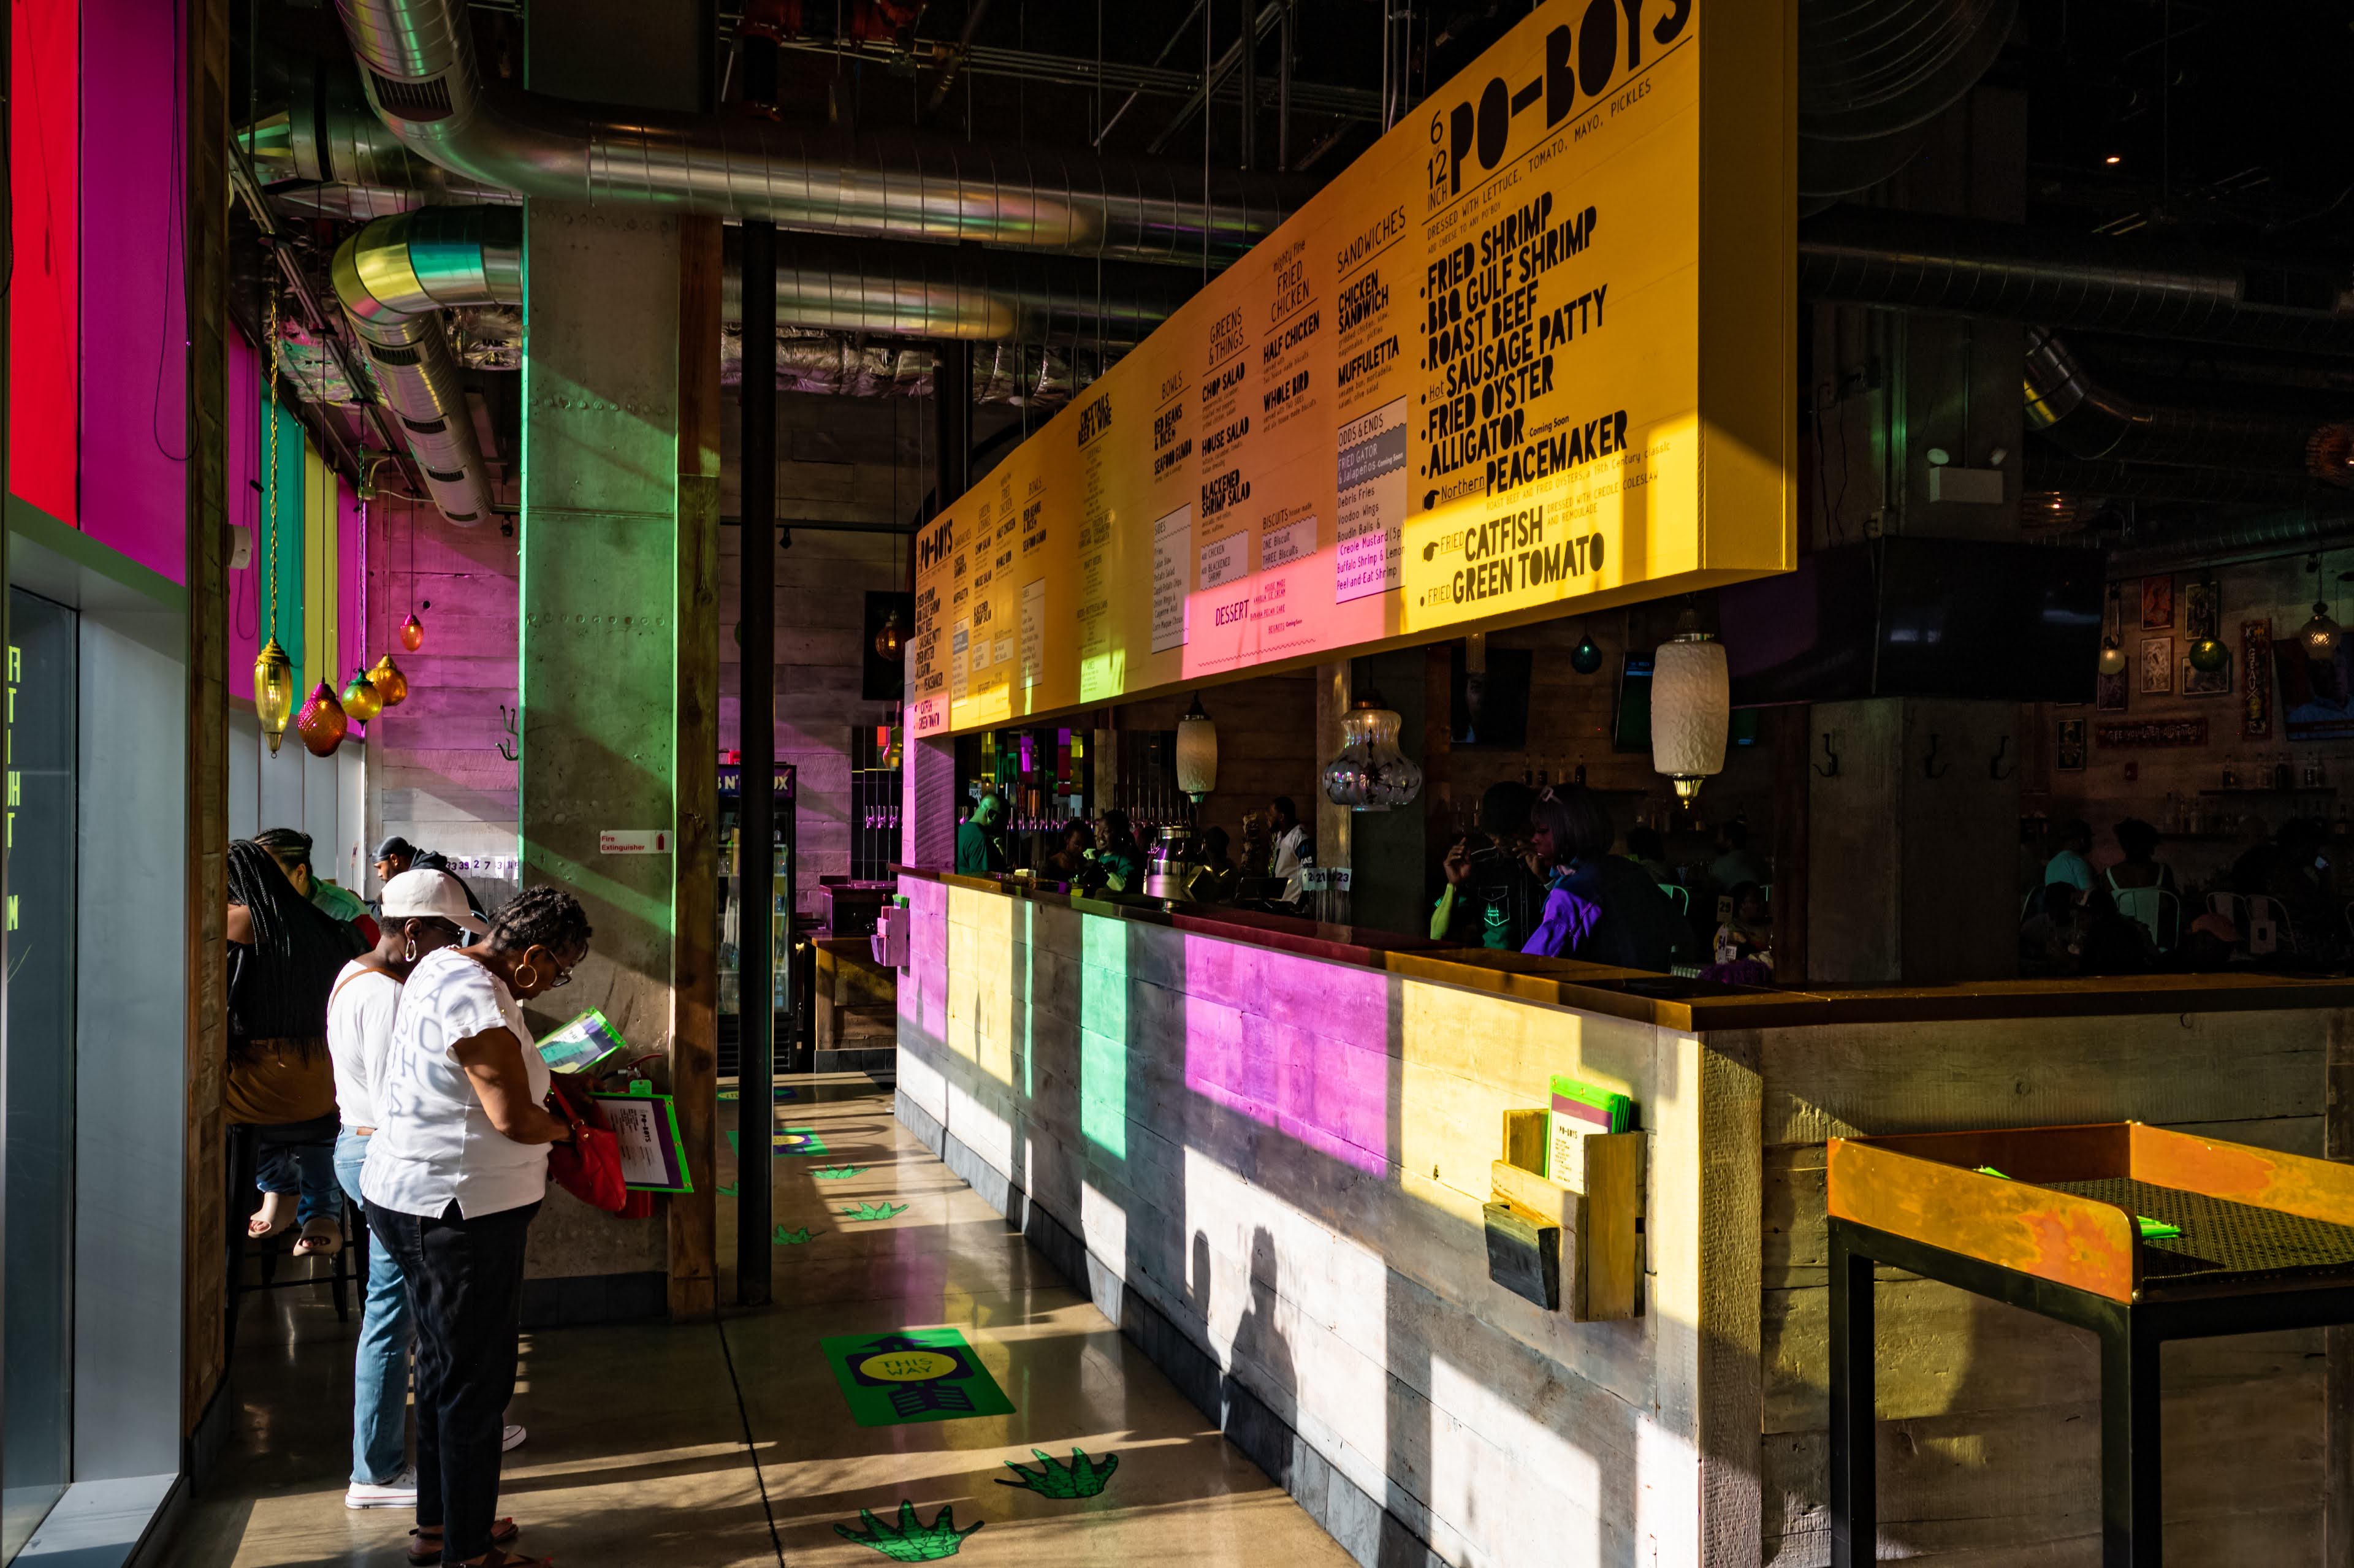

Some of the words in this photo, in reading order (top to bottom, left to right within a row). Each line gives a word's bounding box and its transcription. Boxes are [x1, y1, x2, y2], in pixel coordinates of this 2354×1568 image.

[1431, 110, 1443, 144] 6
[1427, 210, 1458, 241] DRESSED
[1462, 196, 1479, 218] WITH
[1483, 169, 1522, 204] LETTUCE,
[1528, 139, 1567, 173] TOMATO,
[1575, 114, 1603, 142] MAYO,
[1611, 78, 1651, 117] PICKLES
[1428, 150, 1447, 190] 12
[1428, 182, 1447, 212] INCH
[1338, 205, 1406, 273] SANDWICHES
[1428, 244, 1436, 255] ADD
[1439, 229, 1457, 248] CHEESE
[1460, 223, 1466, 234] TO
[1469, 217, 1479, 227] ANY
[1428, 242, 1474, 300] FRIED
[1481, 191, 1552, 267] SHRIMP
[1278, 260, 1302, 296] FRIED
[1428, 288, 1461, 336] BBQ
[1466, 253, 1513, 312] GULF
[1519, 205, 1596, 283] SHRIMP
[1271, 278, 1309, 322] CHICKEN
[1339, 268, 1378, 314] CHICKEN
[1211, 306, 1242, 343] GREENS
[1339, 284, 1388, 335] SANDWICH
[1429, 308, 1486, 371] ROAST
[1492, 280, 1538, 340] BEEF
[1209, 348, 1214, 366] &
[1215, 327, 1243, 362] THINGS
[1263, 335, 1282, 365] HALF
[1285, 310, 1319, 349] CHICKEN
[1429, 380, 1444, 401] Hot
[1446, 322, 1533, 398] SAUSAGE
[1540, 283, 1607, 355] PATTY
[1338, 335, 1400, 388] MUFFULETTA
[1162, 370, 1183, 400] BOWLS
[1202, 377, 1220, 402] CHOP
[1222, 362, 1244, 390] SALAD
[1263, 381, 1290, 413] WHOLE
[1293, 370, 1309, 397] BIRD
[1429, 392, 1476, 443] FRIED
[1482, 354, 1553, 419] OYSTER
[1081, 392, 1109, 426] COCKTAILS
[1098, 407, 1111, 432] WINE
[1154, 416, 1164, 436] RED
[1165, 403, 1183, 427] BEANS
[1160, 426, 1171, 448] RICE
[1202, 430, 1224, 457] HOUSE
[1227, 416, 1249, 444] SALAD
[1339, 427, 1356, 447] ODDS
[1358, 423, 1362, 437] &
[1364, 413, 1383, 435] ENDS
[1428, 408, 1525, 480] ALLIGATOR
[1529, 421, 1552, 438] Coming
[1554, 415, 1569, 428] Soon
[1154, 450, 1175, 476] SEAFOOD
[1176, 438, 1192, 463] GUMBO
[1338, 454, 1354, 471] FRIED
[1356, 443, 1377, 463] GATOR
[1344, 461, 1376, 482] Jalapeños
[1378, 457, 1392, 467] Coming
[1393, 452, 1403, 462] Soon
[1441, 476, 1485, 501] Northern
[1486, 409, 1628, 498] PEACEMAKER
[1202, 468, 1240, 503] BLACKENED
[1487, 497, 1503, 511] ROAST
[1507, 493, 1520, 505] BEEF
[1523, 489, 1534, 499] AND
[1537, 481, 1552, 493] FRIED
[1594, 464, 1608, 476] 19th
[1612, 452, 1640, 468] Century
[1645, 441, 1670, 458] classic
[1547, 497, 1573, 514] DRESSED
[1577, 493, 1590, 504] WITH
[1594, 482, 1618, 498] CREOLE
[1623, 470, 1658, 490] COLESLAW
[1202, 493, 1225, 518] SHRIMP
[1228, 481, 1250, 507] SALAD
[1338, 492, 1356, 508] Debris
[1359, 487, 1374, 500] Fries
[1338, 511, 1359, 525] Voodoo
[1363, 503, 1379, 516] Wings
[1547, 516, 1558, 526] AND
[1562, 503, 1598, 522] REMOULADE
[1263, 508, 1288, 530] BISCUITS
[1302, 502, 1311, 511] made
[1338, 527, 1356, 542] Boudin
[1359, 523, 1373, 535] Balls
[1376, 518, 1381, 529] &
[1440, 531, 1464, 552] FRIED
[1465, 505, 1543, 561] CATFISH
[921, 518, 953, 573] PO-BOYS
[1208, 544, 1224, 558] CHICKEN
[1263, 540, 1271, 550] ONE
[1274, 532, 1290, 546] Biscuit
[1263, 552, 1276, 565] THREE
[1279, 546, 1298, 560] Biscuits
[1341, 542, 1359, 555] Creole
[1208, 557, 1230, 573] BLACKENED
[1338, 560, 1356, 573] Buffalo
[1358, 554, 1377, 567] Shrimp
[1380, 550, 1383, 561] &
[1386, 546, 1405, 559] Lemon
[1376, 566, 1396, 580] Shrimp
[1428, 584, 1450, 604] FRIED
[1453, 557, 1512, 604] GREEN
[1518, 532, 1604, 590] TOMATO
[1216, 599, 1249, 626] DESSERT
[2246, 648, 2258, 700] GEAUX
[2128, 730, 2138, 739] YOU
[1316, 872, 1325, 882] 21
[1337, 872, 1349, 881] 23
[1560, 1126, 1578, 1139] PO-BOYS
[878, 1358, 932, 1368] THIS
[887, 1366, 931, 1376] WAY
